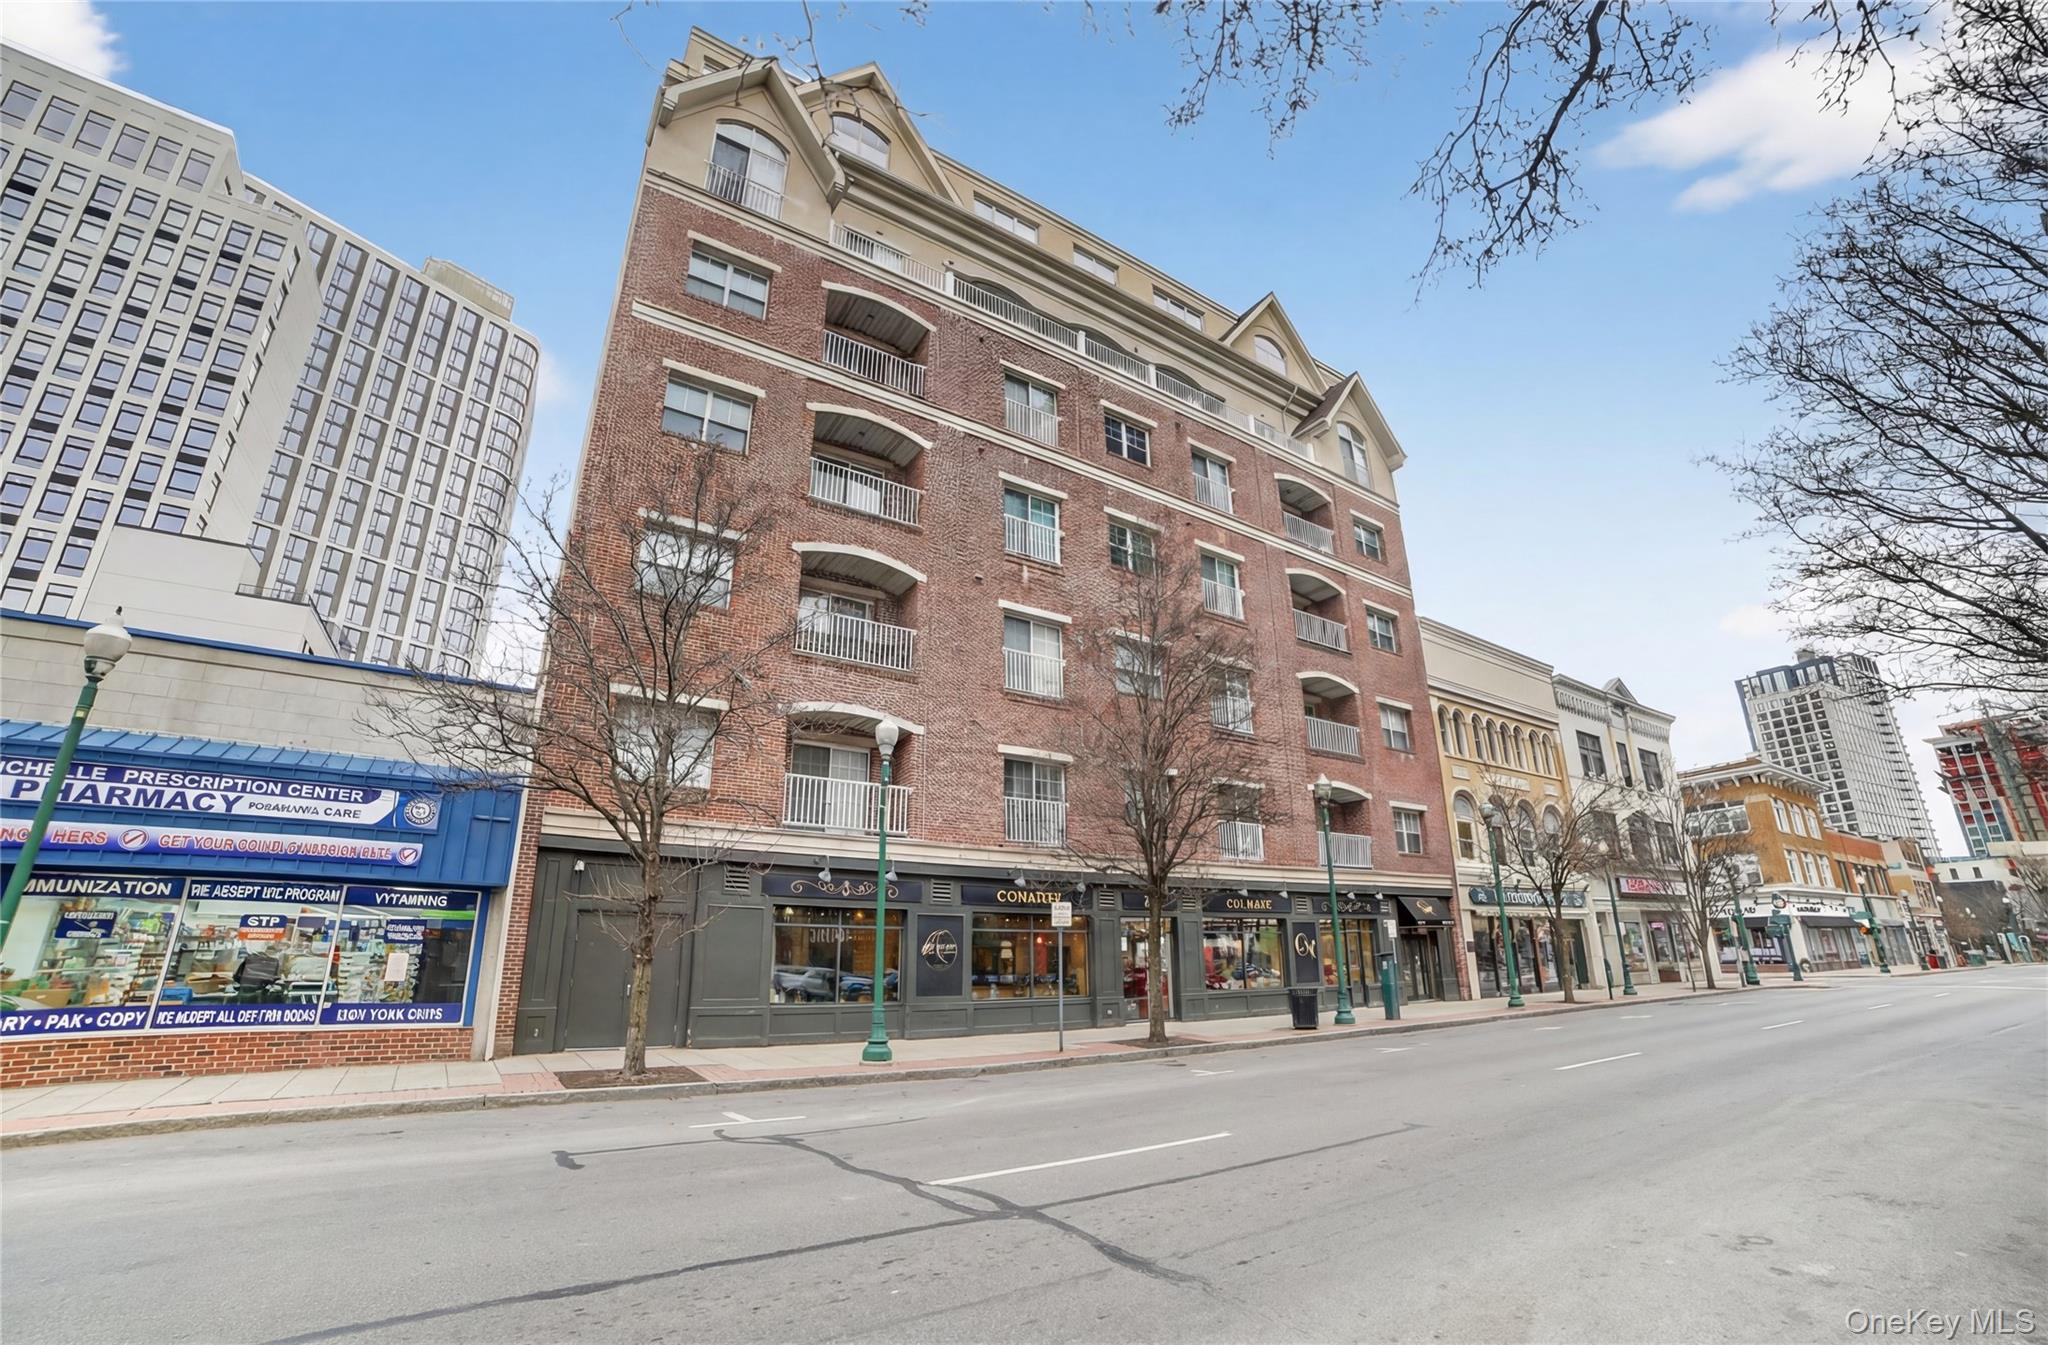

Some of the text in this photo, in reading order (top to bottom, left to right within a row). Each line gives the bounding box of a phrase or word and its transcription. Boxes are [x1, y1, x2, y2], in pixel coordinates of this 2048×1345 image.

[123, 769, 282, 795] PRESCRIPTION
[288, 783, 364, 803] CENTER
[10, 779, 244, 814] PHARMACY
[324, 807, 362, 819] CARE
[51, 829, 108, 845] HERS
[159, 833, 191, 848] GET
[192, 836, 234, 851] YOUR
[284, 887, 341, 903] PROGRAM
[0, 1015, 33, 1032] RY
[44, 1013, 84, 1030] PAK
[216, 1009, 235, 1023] ALL
